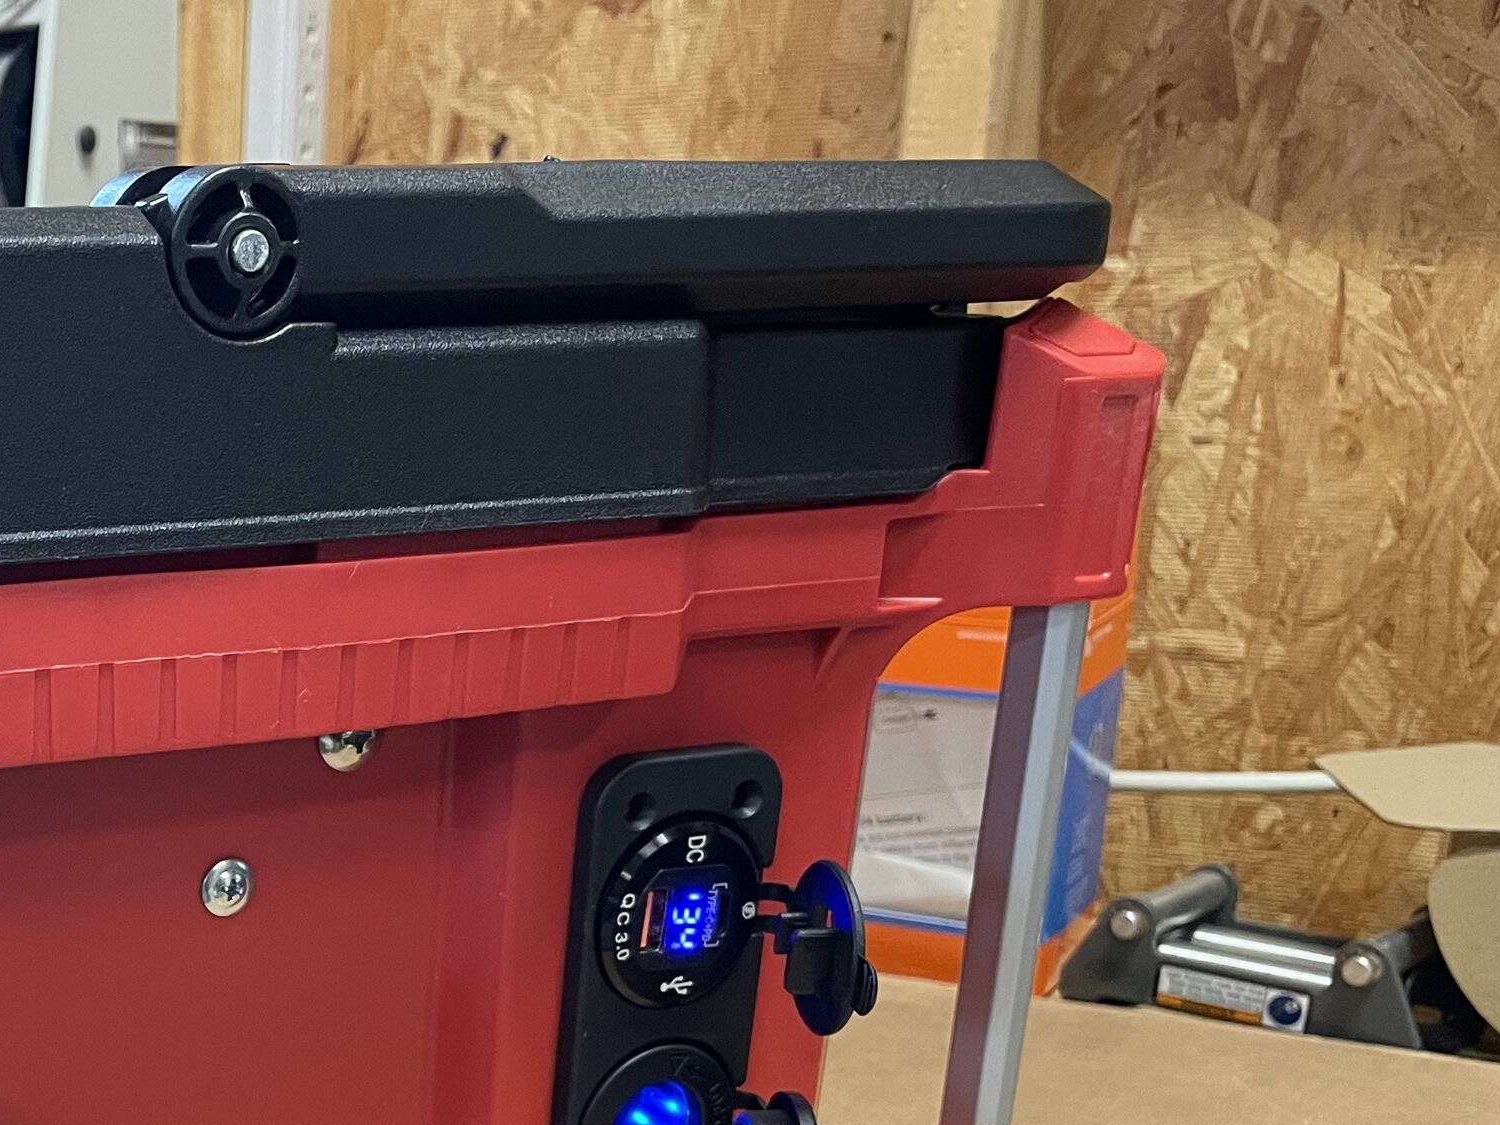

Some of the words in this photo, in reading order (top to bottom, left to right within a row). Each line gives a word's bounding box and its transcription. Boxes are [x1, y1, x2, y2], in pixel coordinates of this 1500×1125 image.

[685, 834, 707, 863] DC
[616, 893, 636, 926] QC
[614, 932, 630, 962] 3.0
